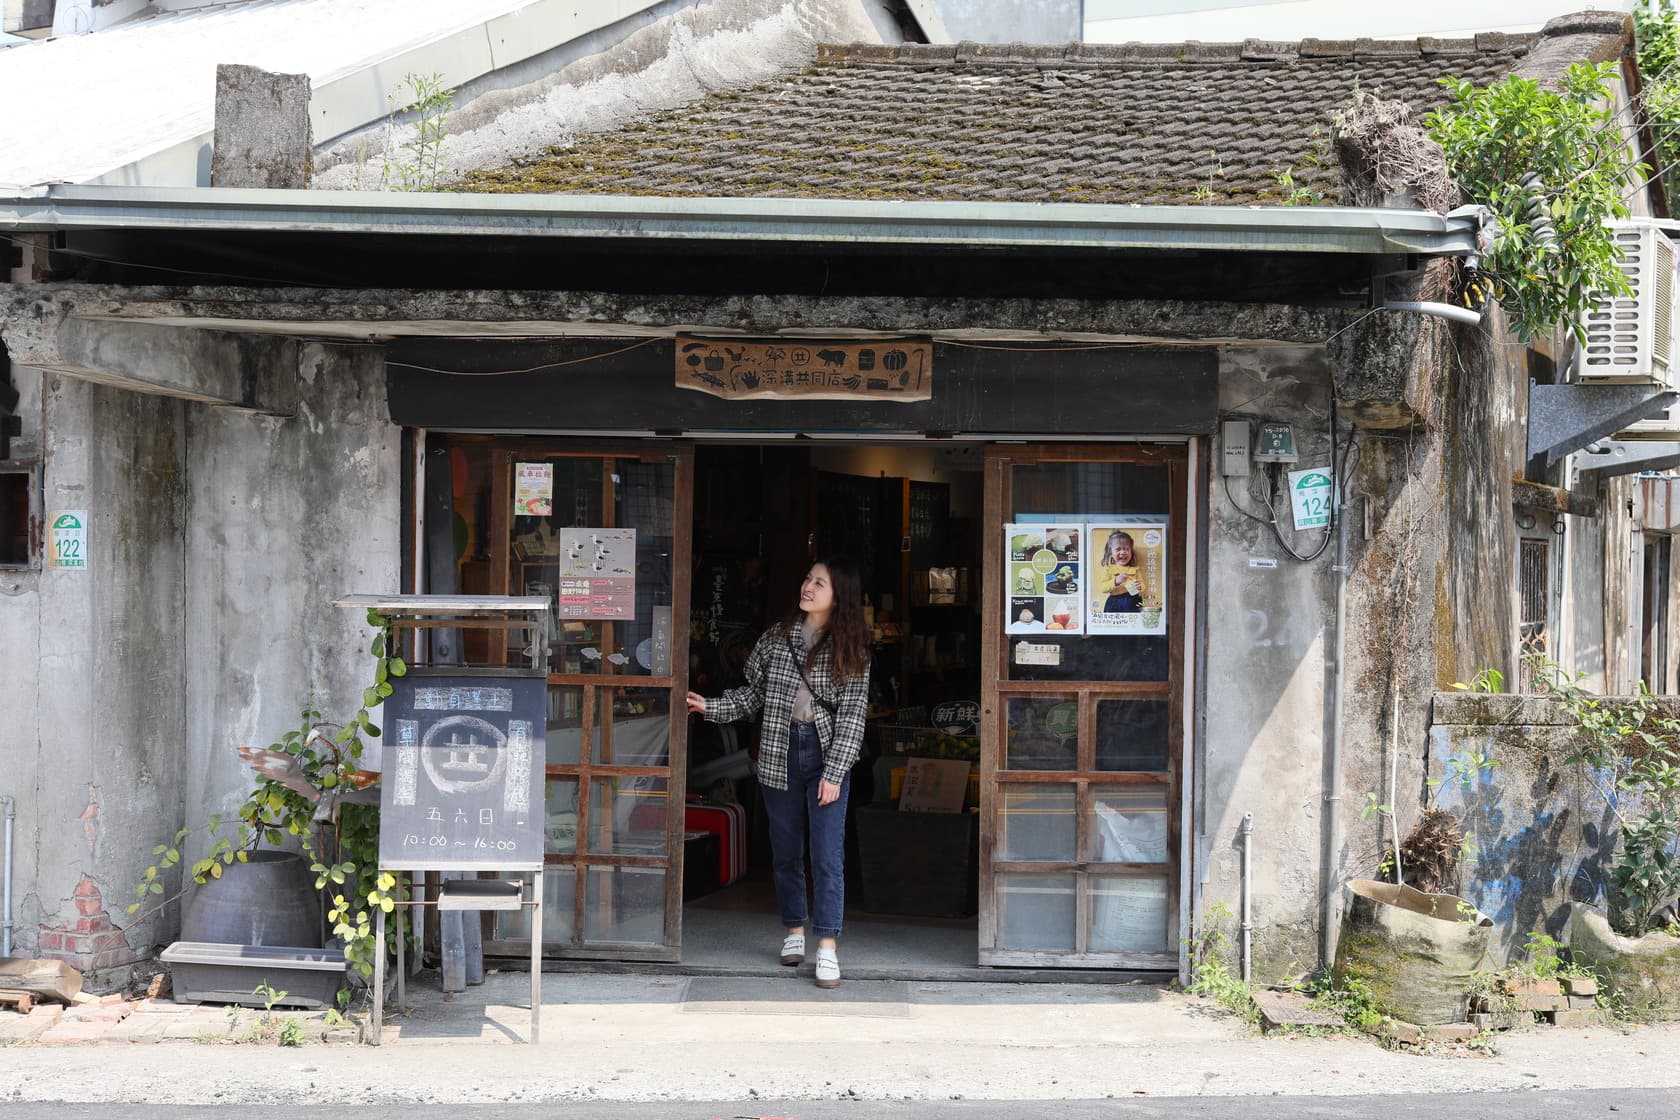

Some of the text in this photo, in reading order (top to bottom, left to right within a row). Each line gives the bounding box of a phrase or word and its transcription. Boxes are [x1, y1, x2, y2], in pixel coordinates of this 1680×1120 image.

[762, 369, 842, 386] 深溝共同店
[1302, 495, 1331, 517] 124
[55, 539, 80, 558] 122
[935, 705, 977, 723] 新鮮
[403, 834, 448, 847] 10:00
[474, 836, 517, 851] 16:00
